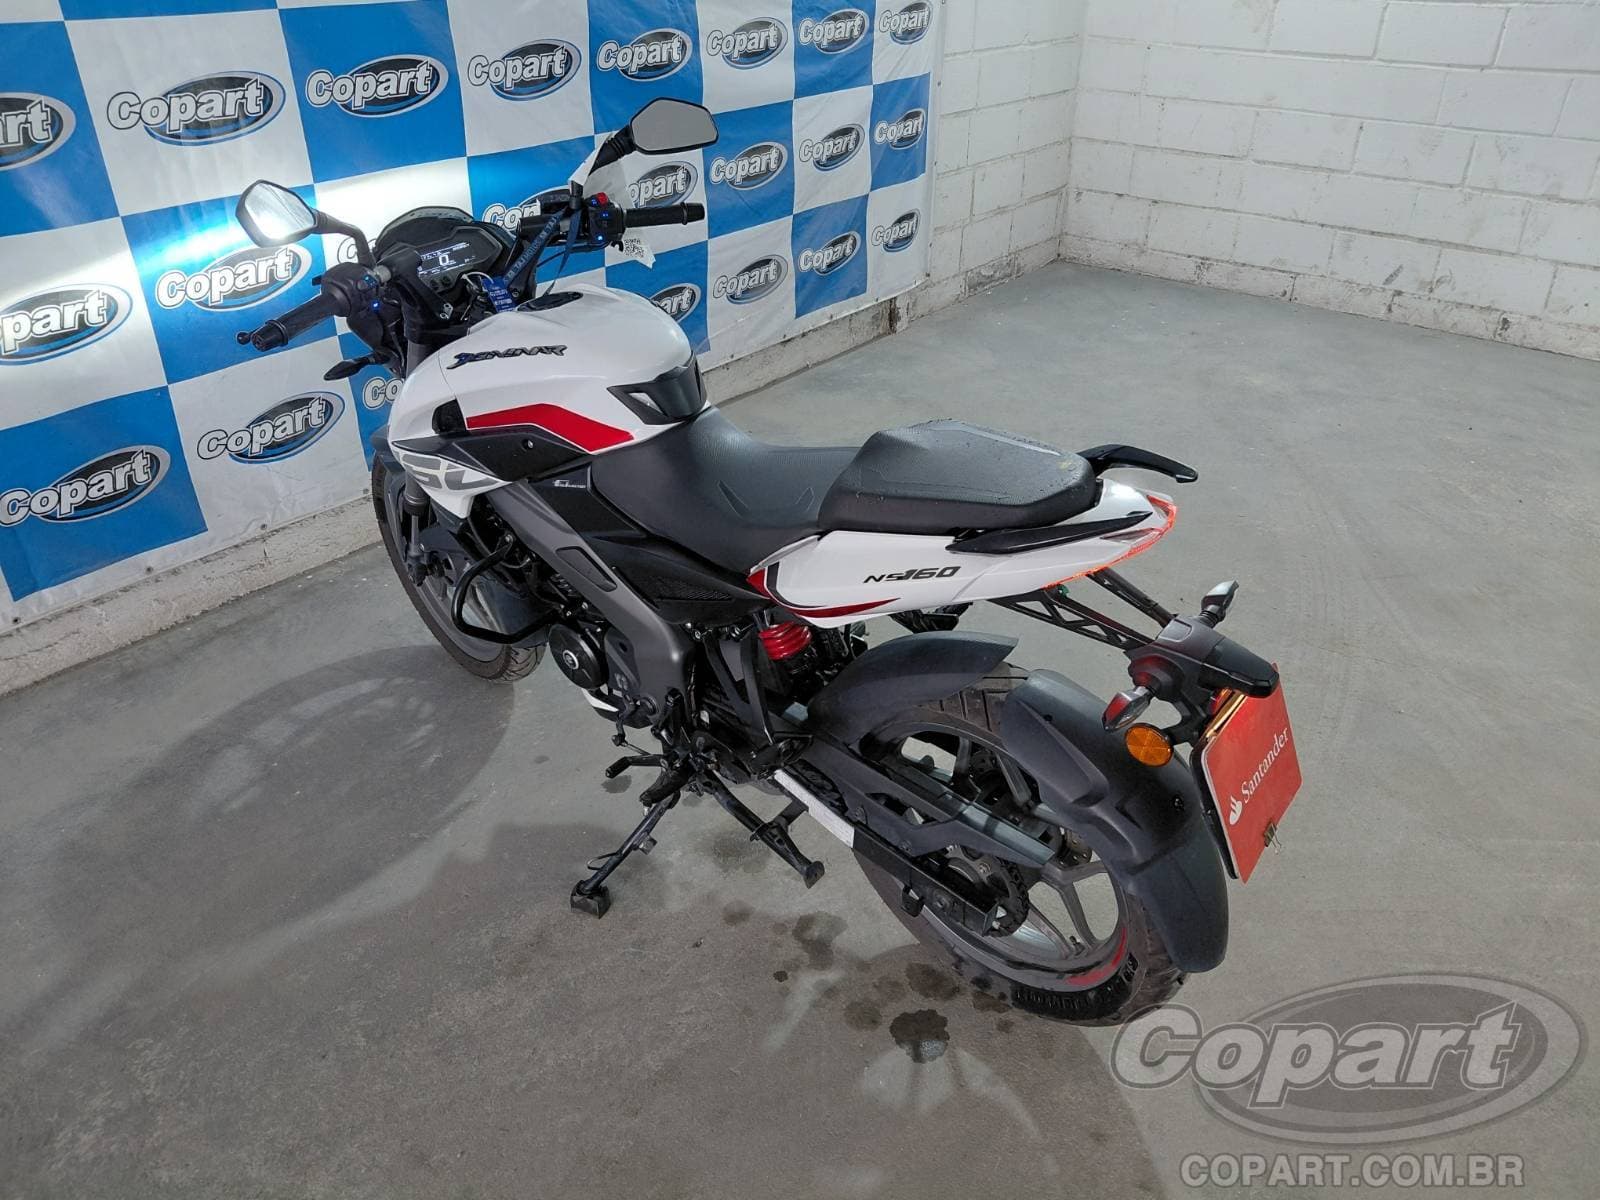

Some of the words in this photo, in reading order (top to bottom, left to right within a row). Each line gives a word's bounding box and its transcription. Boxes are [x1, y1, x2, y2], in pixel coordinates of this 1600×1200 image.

[799, 9, 864, 50] Copart
[880, 1, 930, 33] Copart
[597, 34, 683, 74] Copart
[707, 20, 779, 62] Copart
[306, 61, 434, 109] Copart
[467, 45, 567, 90] Copart
[107, 77, 263, 134] Copart
[799, 128, 860, 168] Copart
[874, 111, 924, 145] Copart
[711, 146, 781, 188] Copart
[872, 214, 918, 247] Copart
[799, 235, 857, 273] Copart
[155, 246, 294, 309] Copart
[713, 259, 779, 300] Copart
[0, 288, 108, 355] part
[198, 395, 326, 460] Copart
[0, 449, 152, 528] Copart
[863, 565, 962, 583] NS160
[1240, 727, 1290, 804] Santander
